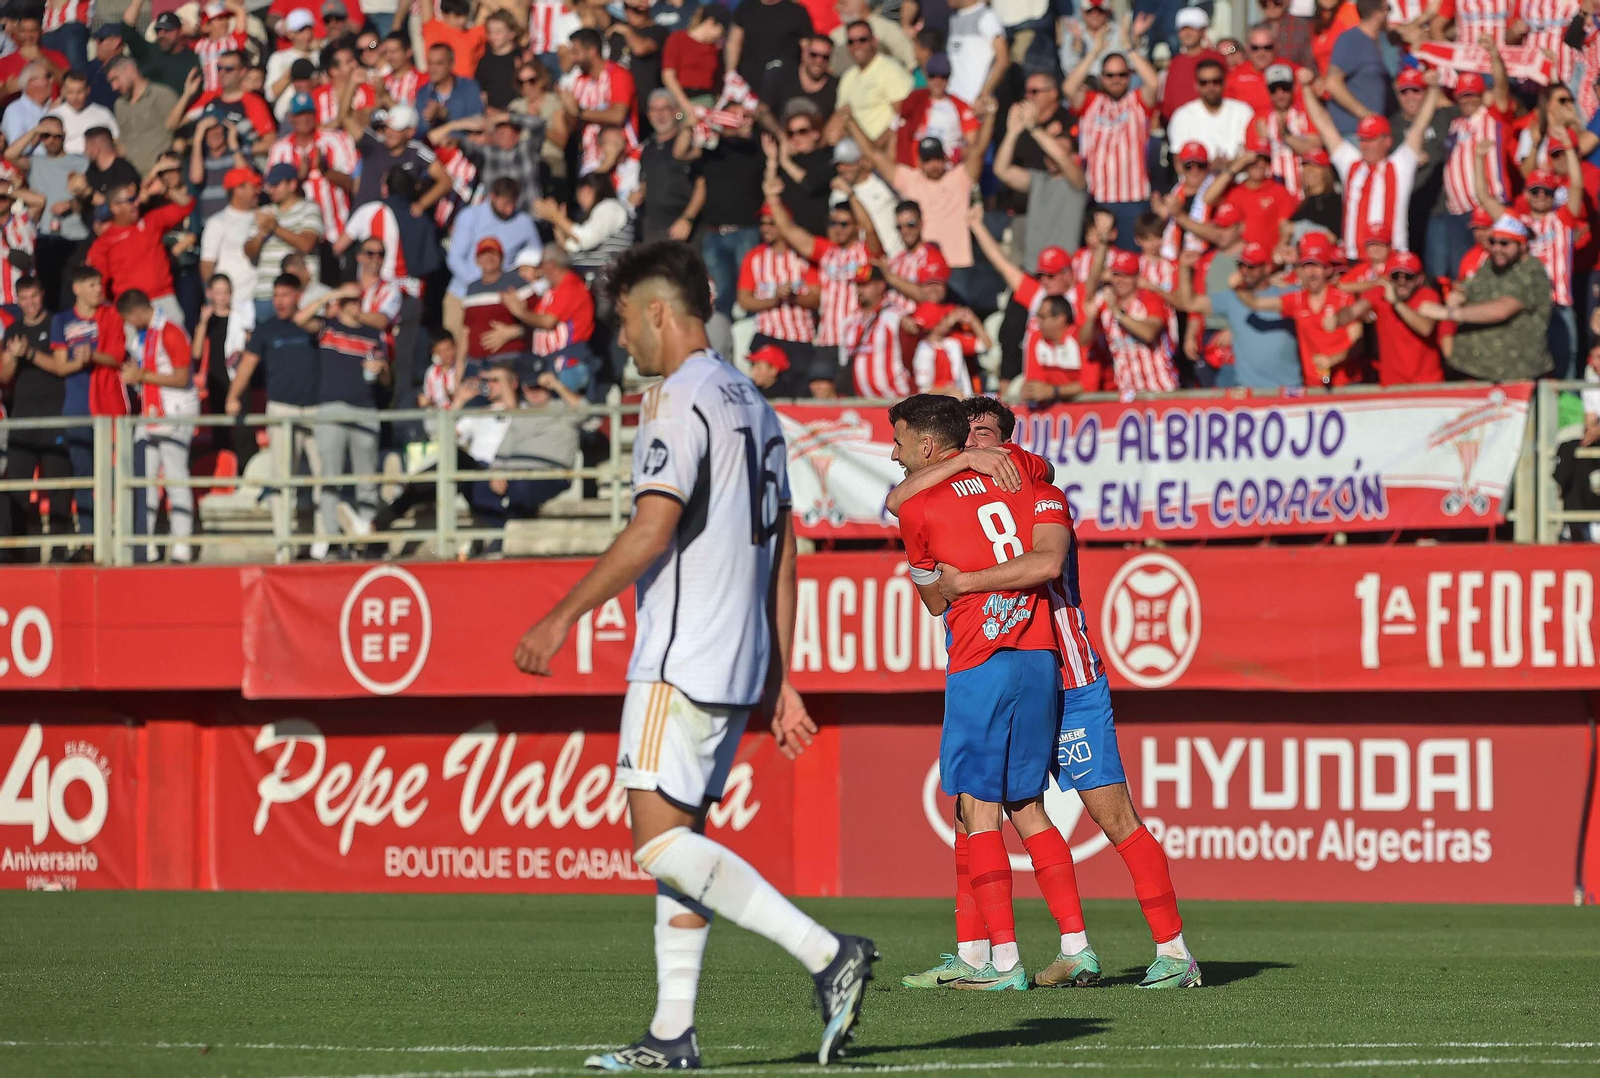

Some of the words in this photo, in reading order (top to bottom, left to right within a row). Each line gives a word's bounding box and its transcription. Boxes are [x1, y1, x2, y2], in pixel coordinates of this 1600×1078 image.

[1118, 408, 1346, 463] ALBIRROJO
[951, 476, 988, 498] IVAN
[1100, 480, 1142, 525] EN
[1157, 480, 1192, 523] EL
[1214, 458, 1388, 521] CORAZÓN
[976, 501, 1025, 565] 8
[1426, 569, 1596, 669] FEDER
[0, 721, 109, 846] 40
[253, 719, 430, 856] Pepe
[1140, 736, 1495, 812] HYUNDAI
[1, 845, 100, 873] Aniversario
[385, 845, 511, 879] BOUTIQUE
[516, 847, 551, 879] DE
[1141, 816, 1315, 861] Permotor
[1317, 817, 1493, 872] Algeciras
